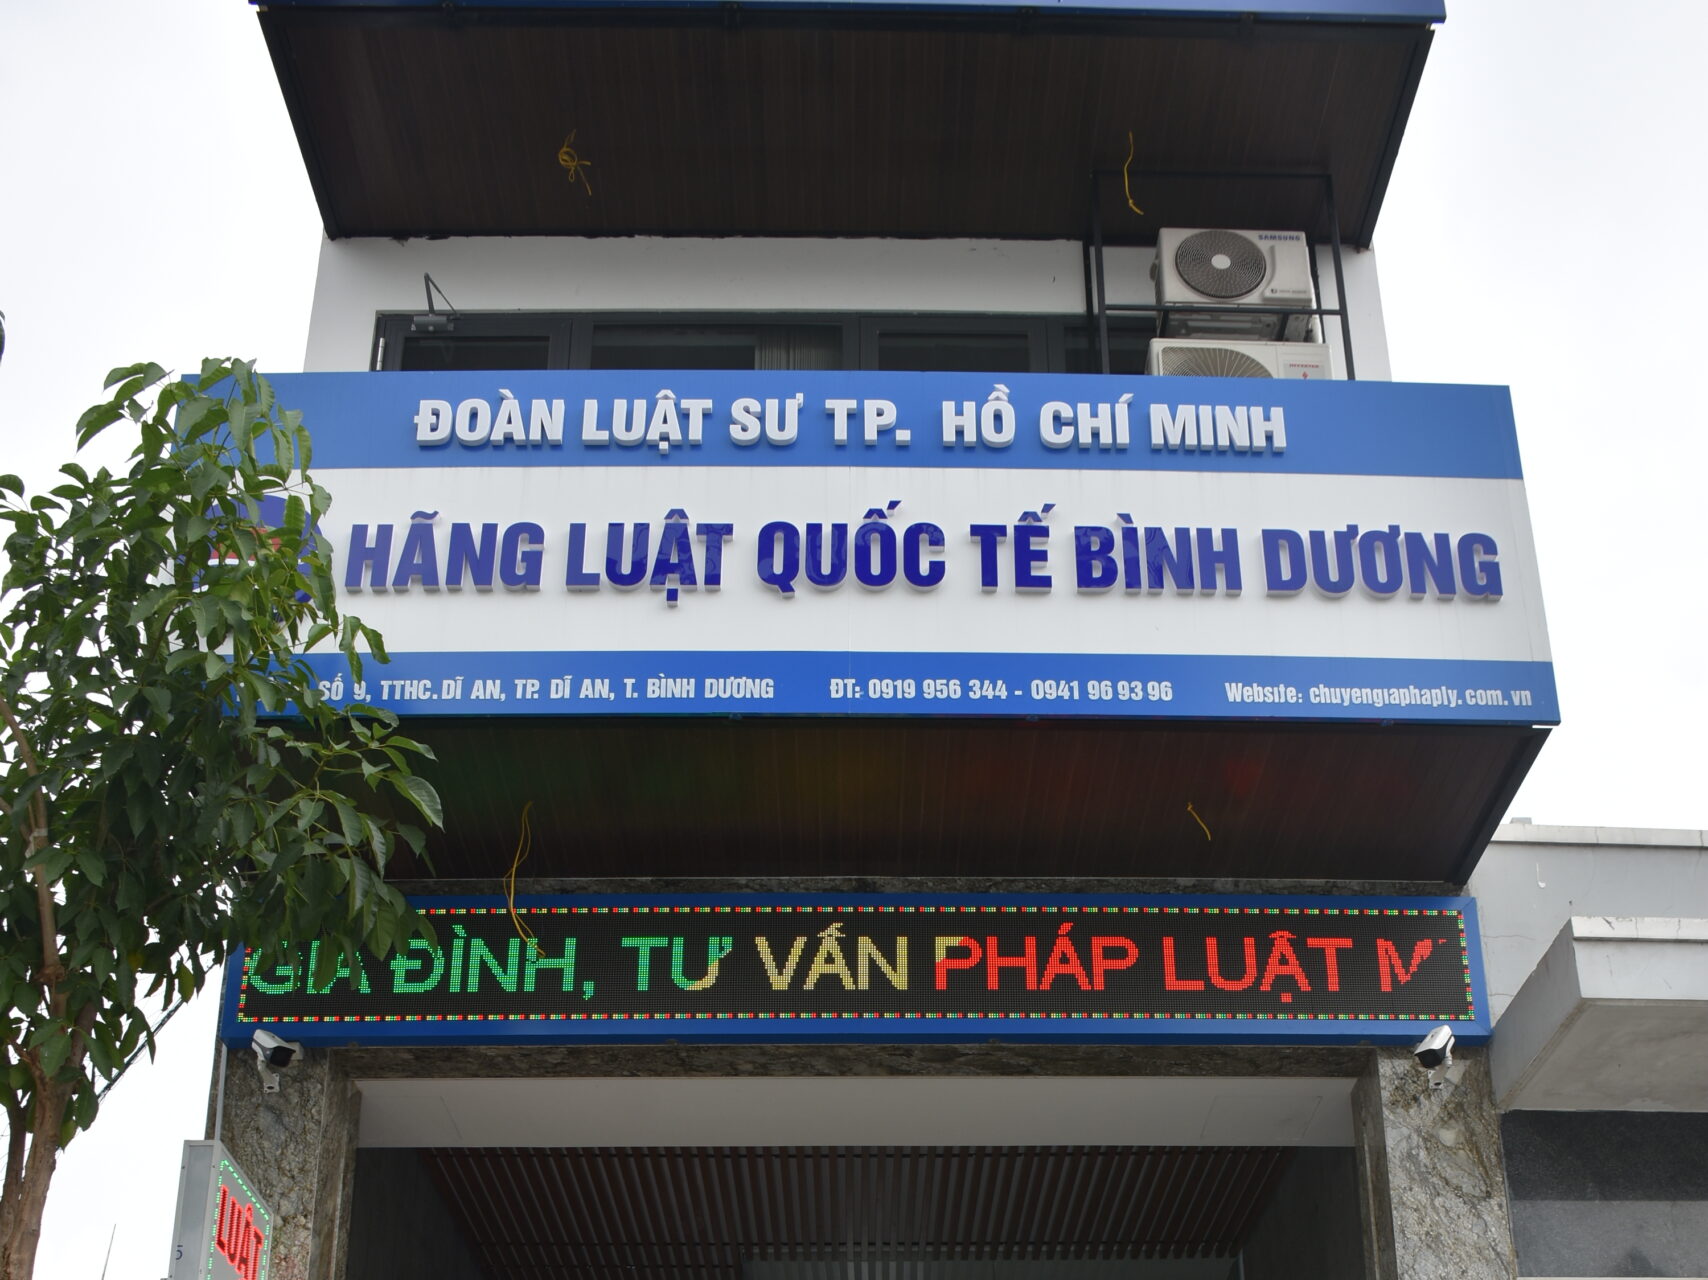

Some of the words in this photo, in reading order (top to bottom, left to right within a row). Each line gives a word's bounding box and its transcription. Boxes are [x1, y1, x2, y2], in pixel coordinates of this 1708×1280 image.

[413, 388, 565, 447] ĐOÀN
[581, 388, 713, 455] LUẬT
[729, 392, 804, 447] SƯ
[825, 399, 911, 447] TP.
[941, 383, 1017, 448] HỒ
[1040, 392, 1134, 449] CHÍ
[1148, 403, 1287, 454] MINH
[344, 509, 545, 593] HÃNG
[564, 507, 734, 607] LUẬT
[756, 500, 947, 598] QUỐC
[970, 503, 1057, 596] TẾ
[1073, 512, 1243, 598] BÌNH
[1261, 523, 1504, 602] DƯƠNG
[317, 672, 344, 700] SỐ
[470, 679, 506, 702] AN,
[514, 678, 539, 700] TP.
[550, 675, 573, 700] DĨ
[579, 678, 615, 701] AN,
[624, 678, 638, 699] T.
[646, 672, 696, 699] BÌNH
[704, 676, 775, 699] DƯƠNG
[829, 678, 863, 699] ĐT:
[868, 679, 917, 700] 0919
[922, 679, 962, 700] 956
[968, 679, 1008, 700] 344
[1030, 679, 1080, 700] 0941
[1087, 680, 1114, 701] 96
[1117, 680, 1144, 701] 93
[1147, 681, 1173, 701] 96
[1224, 682, 1303, 704] Website:
[390, 924, 595, 1000] ĐÌNH,
[621, 936, 733, 991] TƯ
[755, 922, 909, 991] VẤN
[934, 922, 1139, 991] PHÁP
[1163, 930, 1353, 1003] LUẬT
[1375, 937, 1447, 992] M
